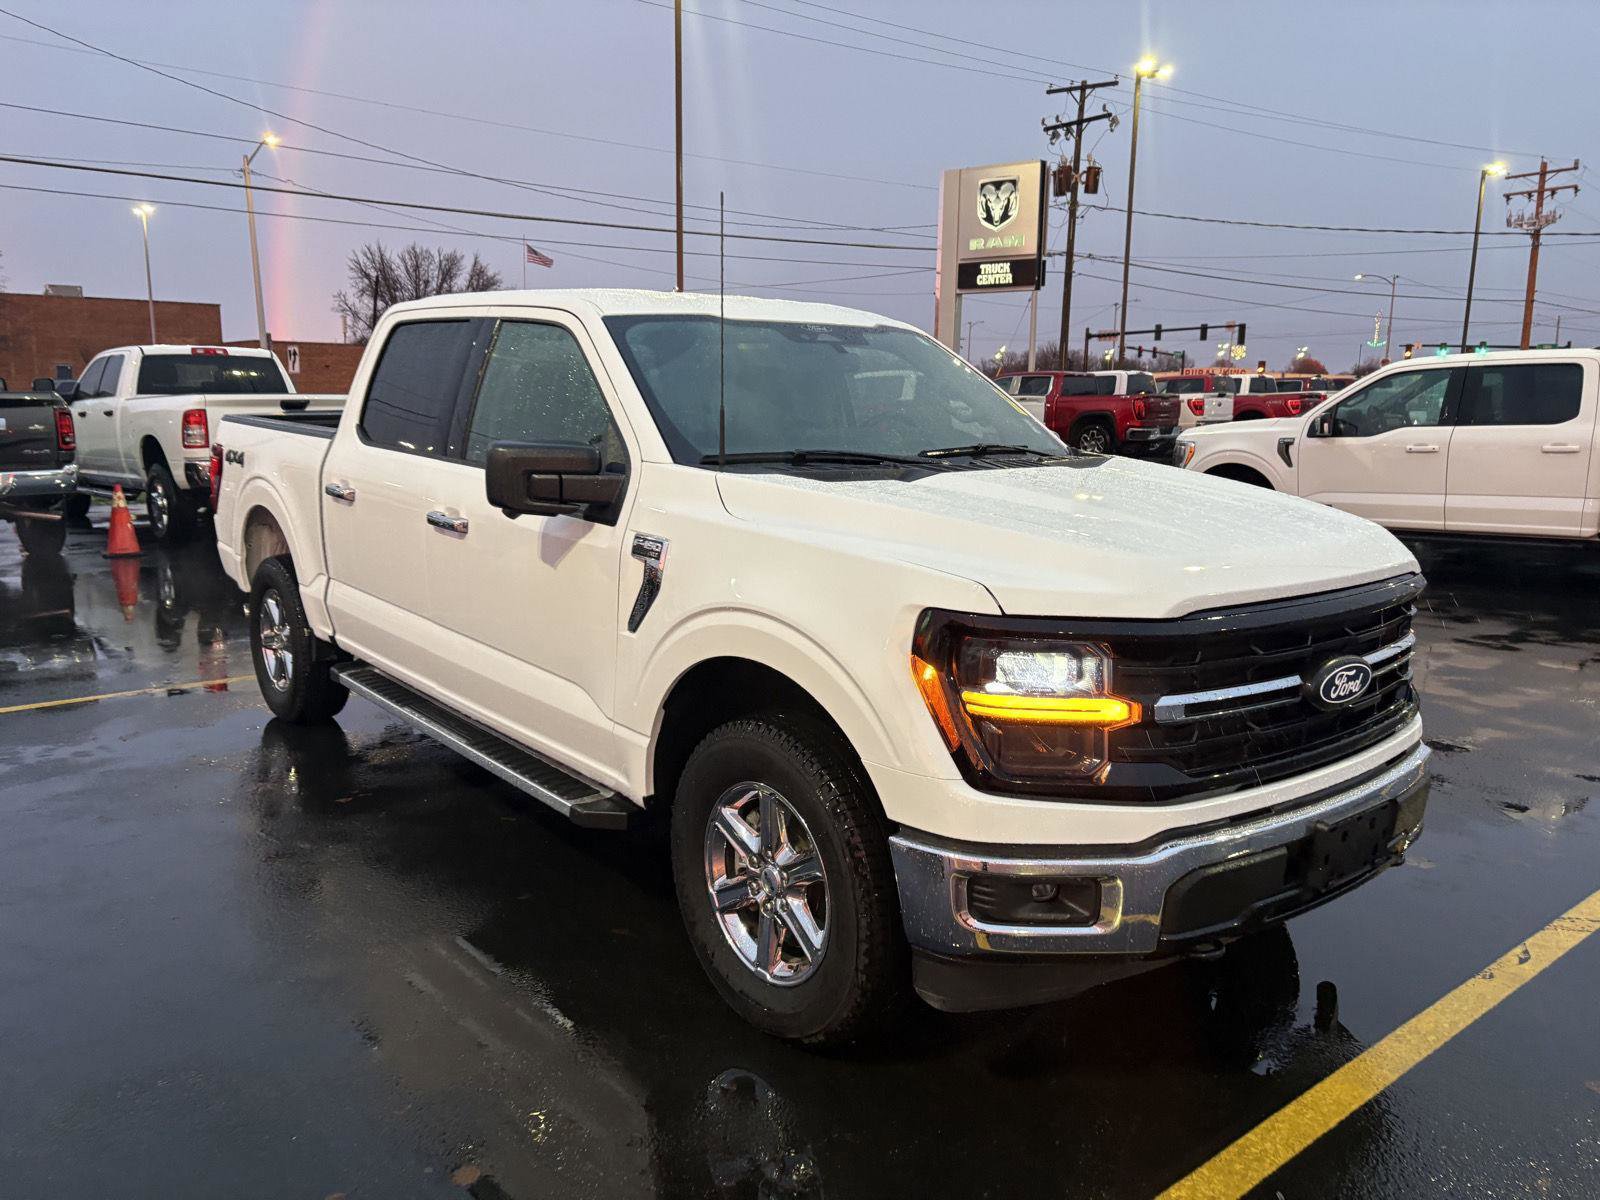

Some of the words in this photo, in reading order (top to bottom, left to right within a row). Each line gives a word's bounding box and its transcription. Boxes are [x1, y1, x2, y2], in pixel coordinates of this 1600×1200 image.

[969, 235, 1025, 251] RAM
[979, 262, 1010, 274] TRUCK
[976, 274, 1012, 285] CENTER
[1330, 669, 1364, 699] Ford
